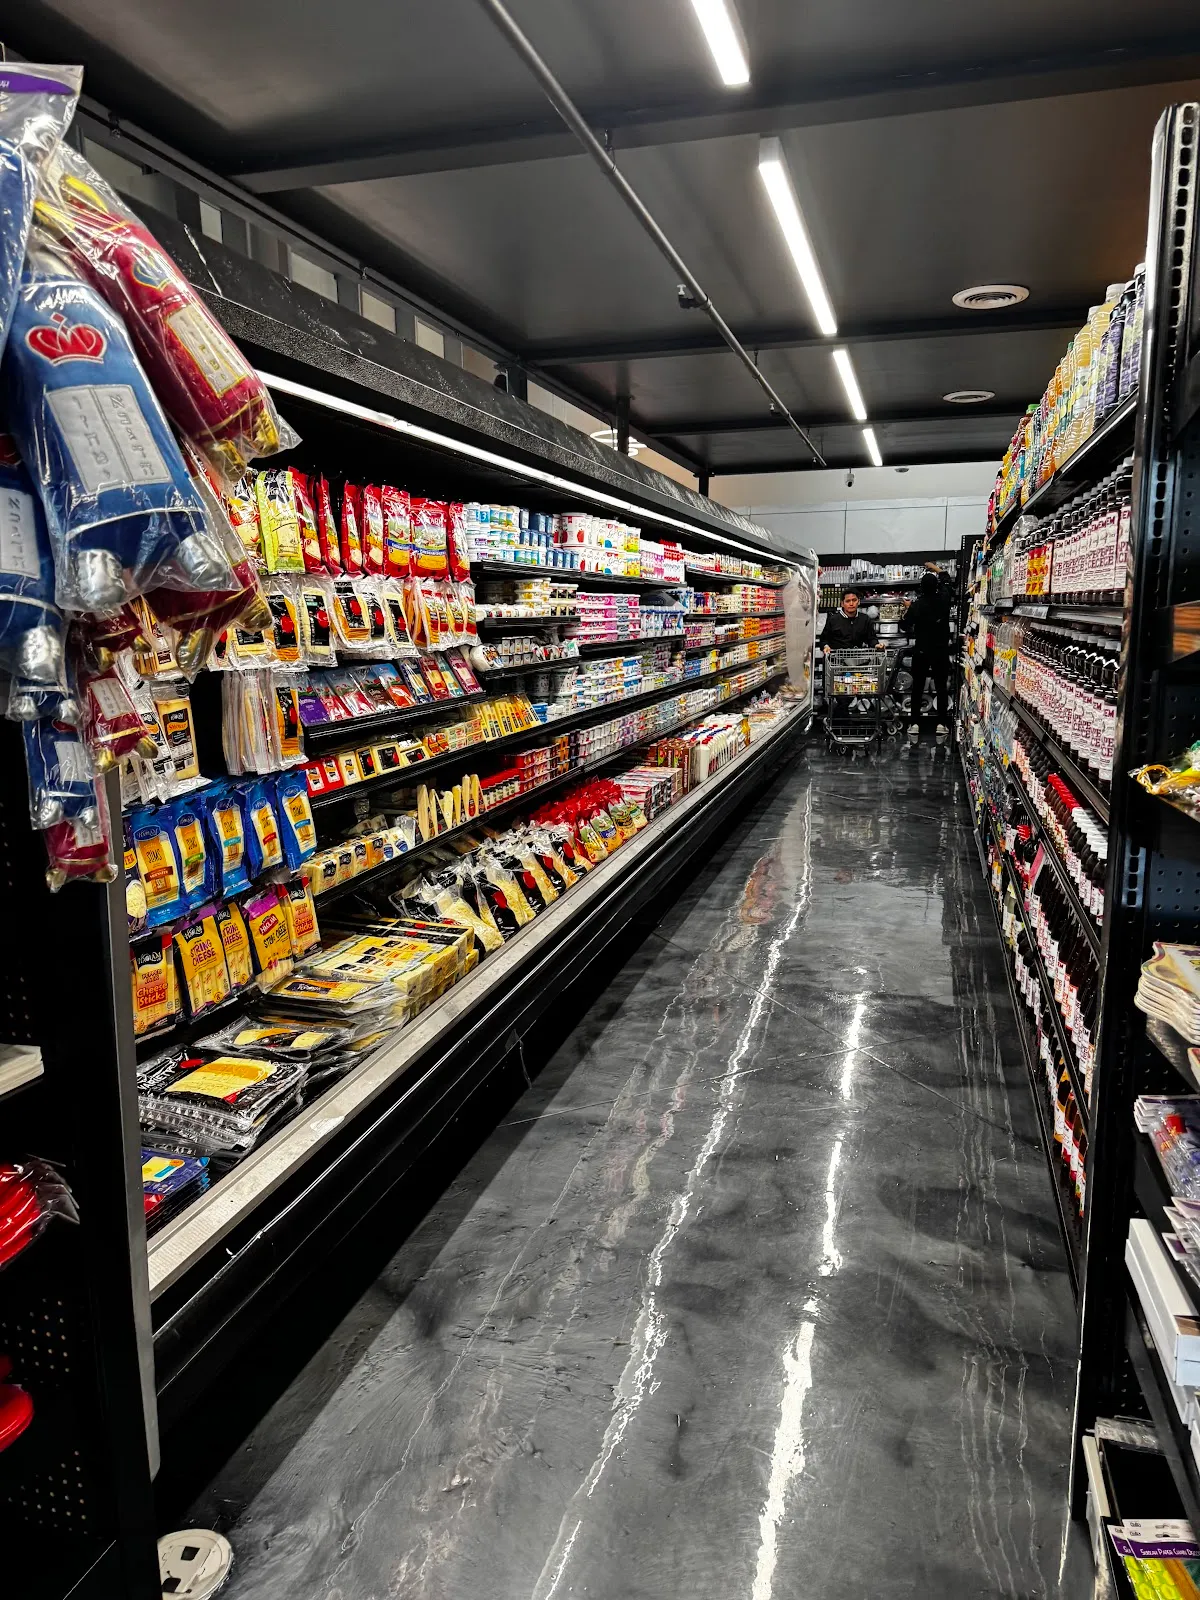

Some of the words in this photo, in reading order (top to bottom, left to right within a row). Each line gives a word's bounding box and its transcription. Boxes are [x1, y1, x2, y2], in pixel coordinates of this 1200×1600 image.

[190, 939, 212, 958] STRING
[192, 949, 216, 966] CHEESE
[137, 983, 168, 998] Cheese
[139, 992, 165, 1006] Sticks
[138, 1064, 177, 1090] VARIETY
